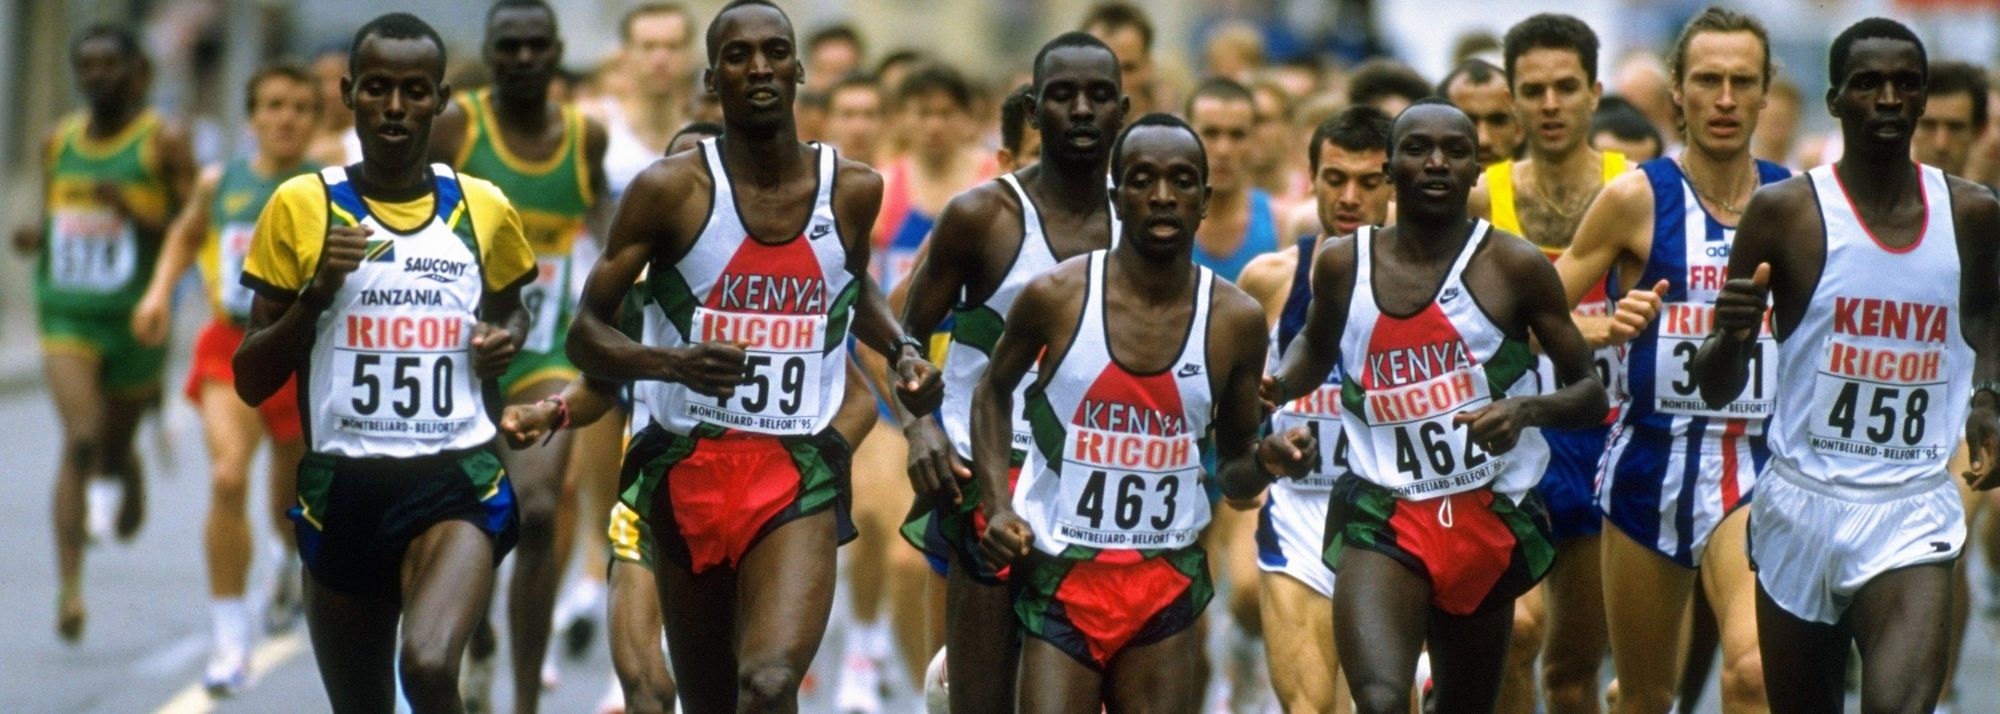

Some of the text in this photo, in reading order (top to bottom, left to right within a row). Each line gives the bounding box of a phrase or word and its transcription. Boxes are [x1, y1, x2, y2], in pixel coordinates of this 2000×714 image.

[404, 257, 467, 277] SAUCONY
[361, 289, 442, 307] TANZANIA
[720, 273, 824, 313] KENYA
[346, 315, 462, 349] RICOH
[702, 313, 816, 350] RICOH
[1834, 297, 1948, 344] KENYA
[1369, 340, 1470, 389] KENYA
[1672, 341, 1764, 400] 31
[1830, 342, 1941, 384] RICOH
[352, 354, 453, 418] 550
[716, 356, 806, 416] 59
[1370, 371, 1475, 424] RICOH
[1083, 399, 1183, 438] KENYA
[1828, 382, 1930, 446] 458
[1075, 430, 1189, 469] RICOH
[1076, 470, 1180, 531] 463
